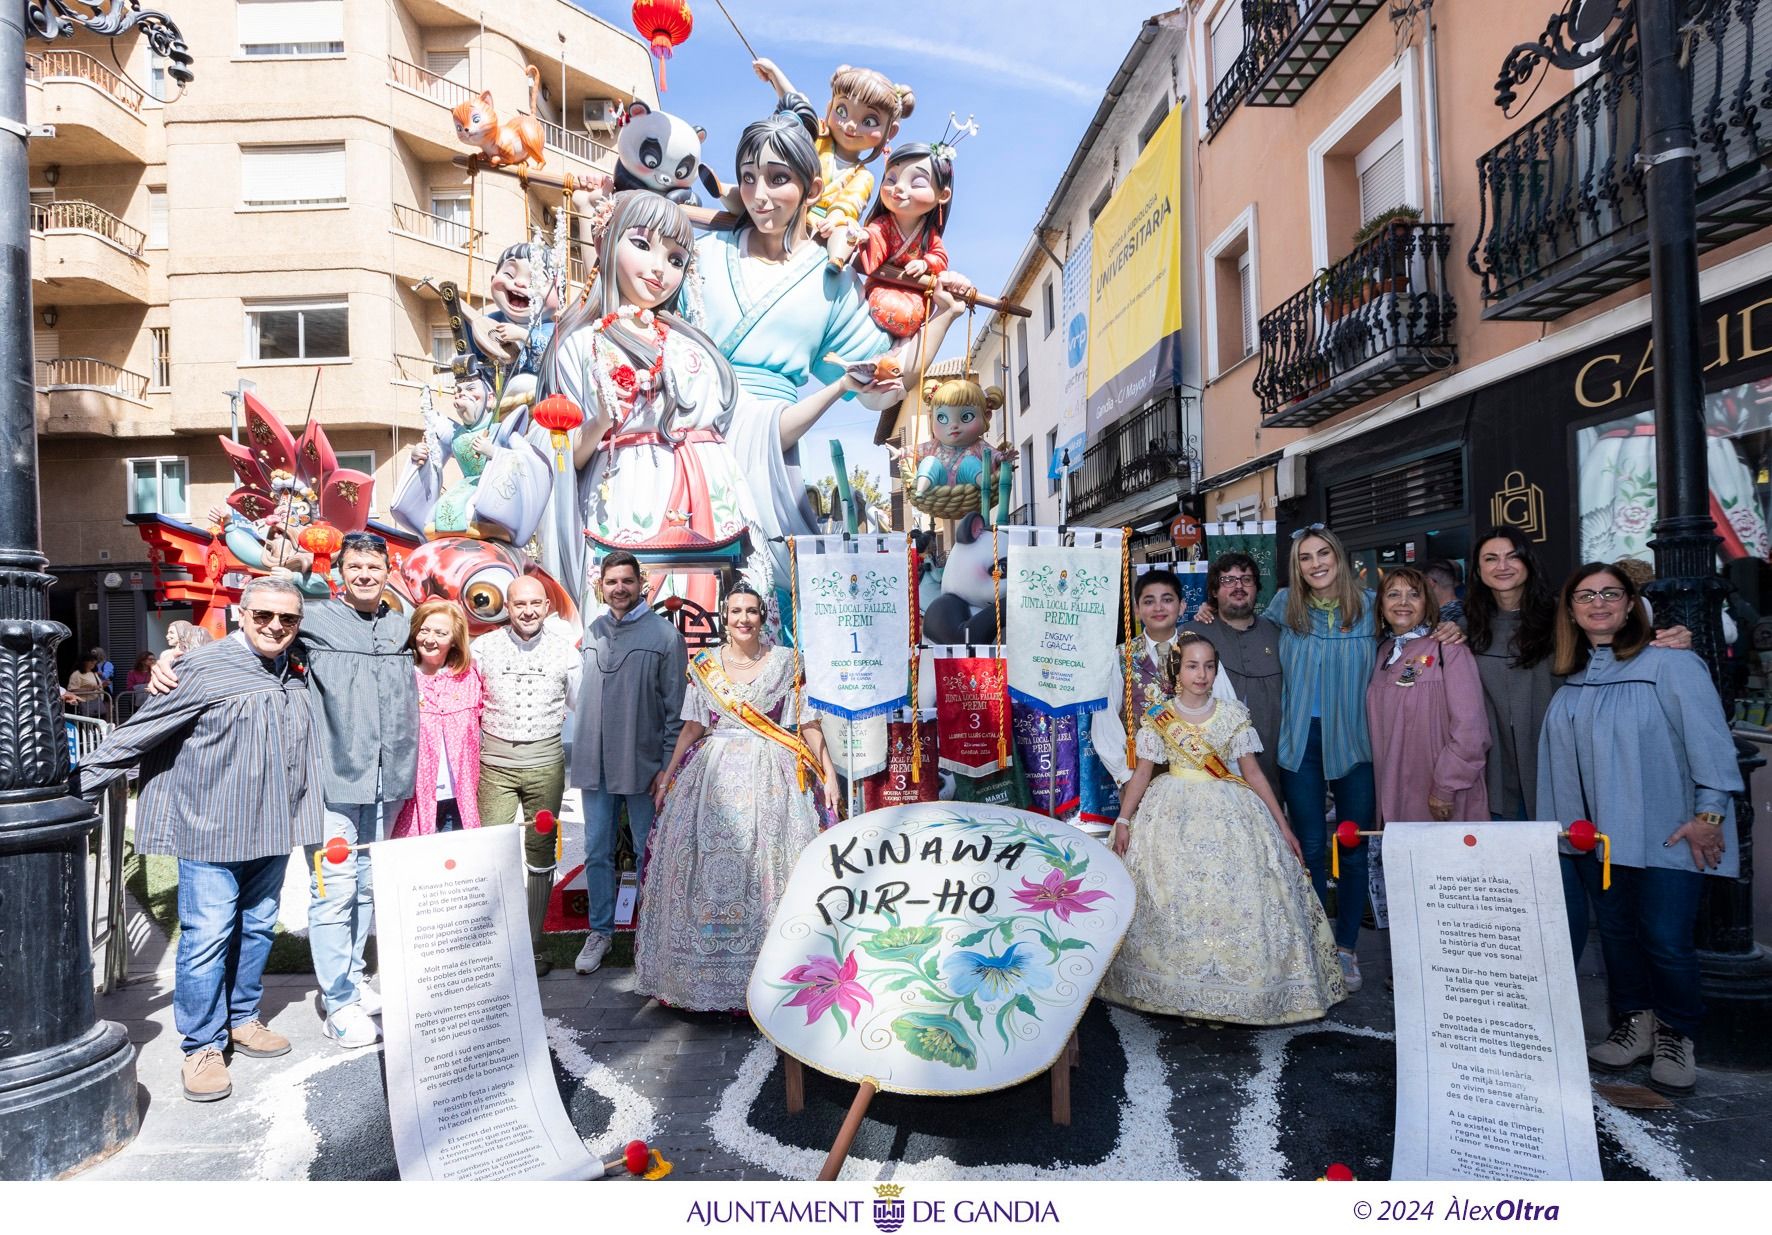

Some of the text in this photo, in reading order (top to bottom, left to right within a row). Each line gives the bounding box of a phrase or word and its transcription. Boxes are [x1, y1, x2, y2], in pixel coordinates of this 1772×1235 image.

[1096, 196, 1172, 294] UNIVERSITARIA
[1174, 519, 1196, 535] ria
[815, 602, 897, 616] JUNTA LOCAL FALLERA
[1020, 596, 1105, 615] JUNTA LOCAL FALLERA
[837, 615, 873, 627] PREMI
[1044, 612, 1079, 626] PREMI
[851, 632, 861, 654] 1
[1045, 632, 1074, 641] ENGINY
[1054, 658, 1085, 668] ESPECIAL
[945, 694, 962, 703] JUNTA
[962, 701, 987, 710] PREMI
[970, 713, 980, 729] 3
[1040, 754, 1051, 770] 5
[895, 774, 906, 790] 3
[985, 791, 1008, 802] MARTÍ
[830, 833, 1027, 880] KINAWA
[815, 879, 996, 926] DIR-HO
